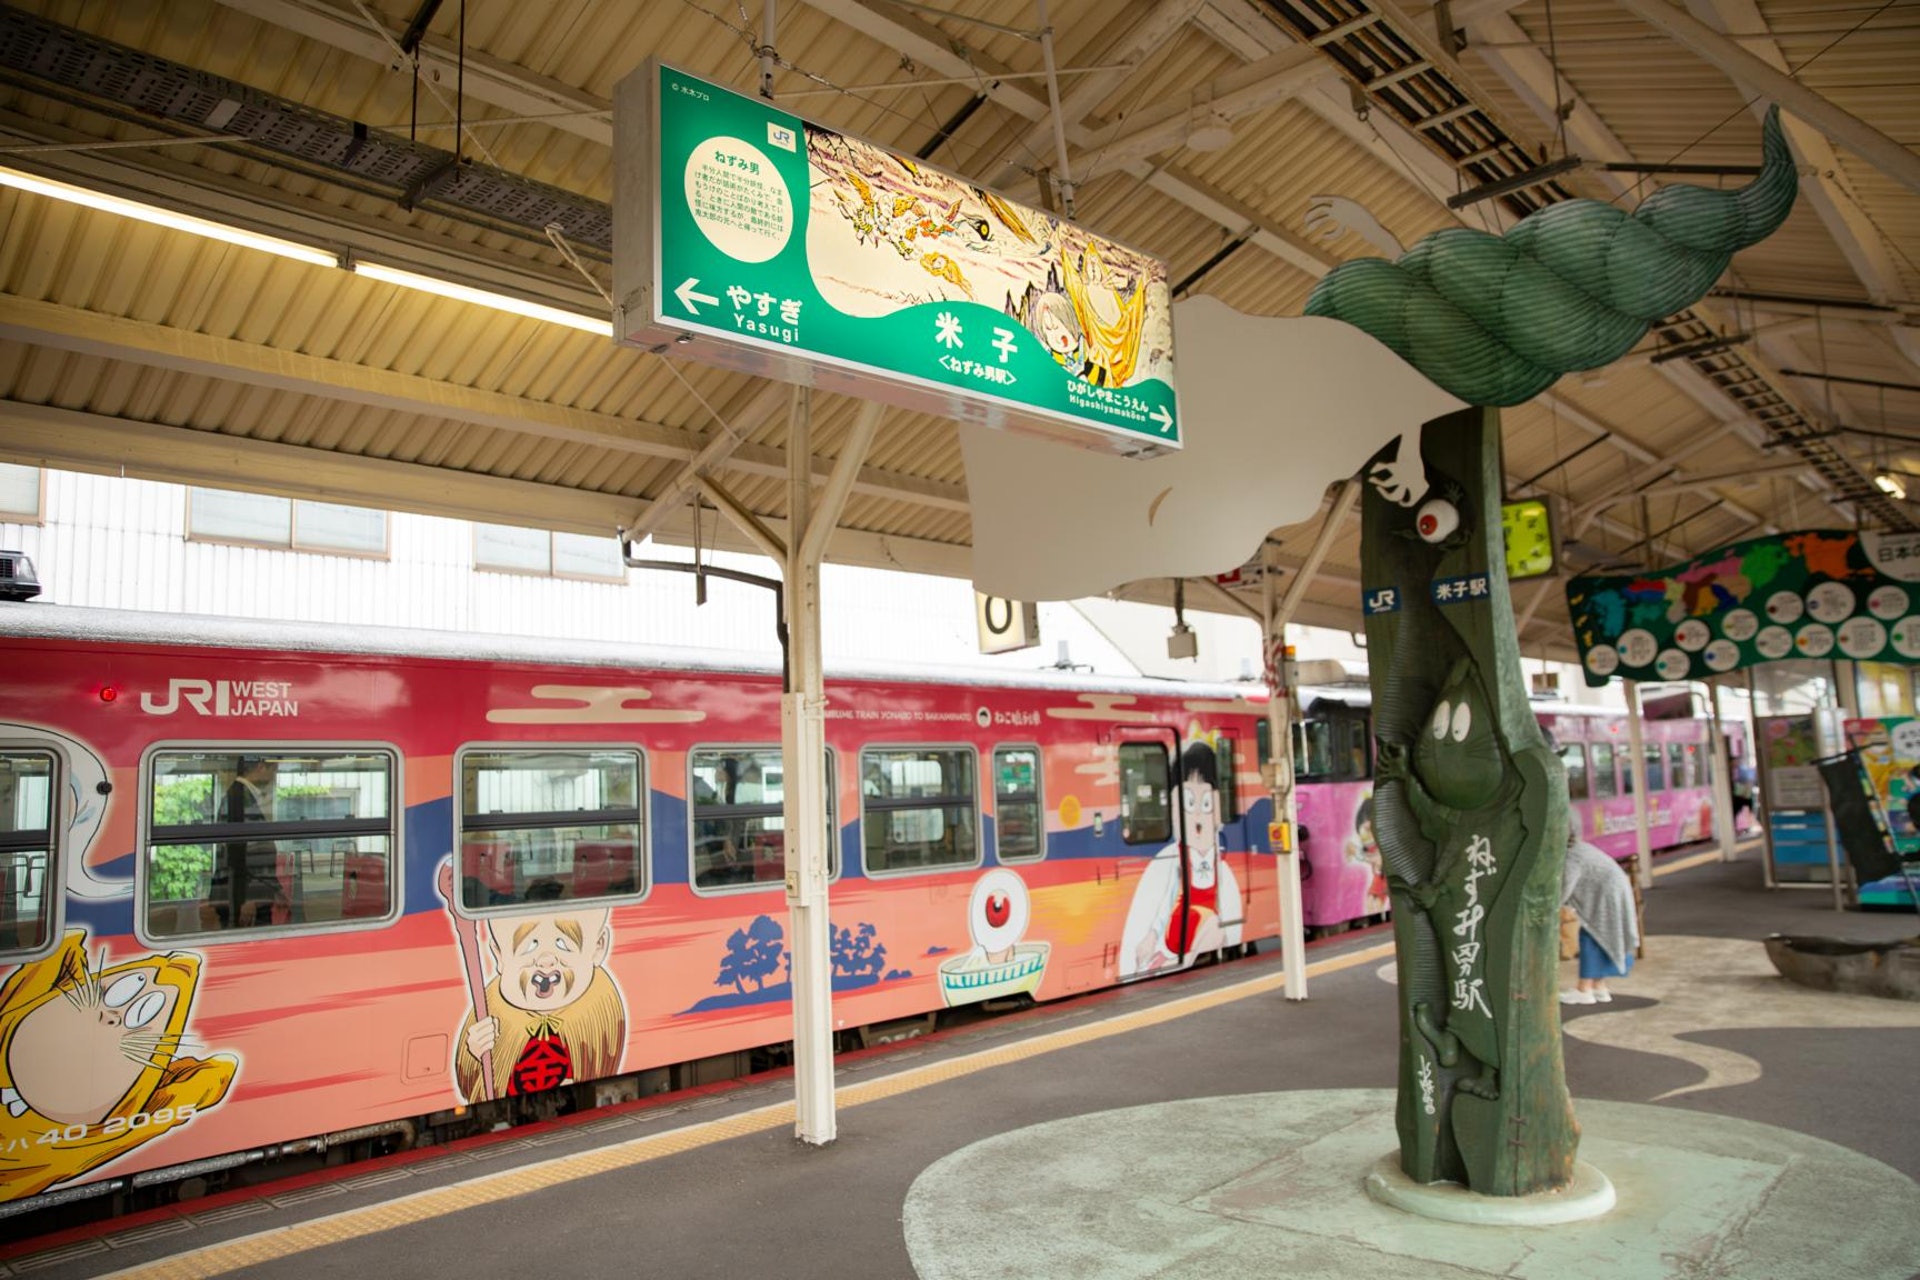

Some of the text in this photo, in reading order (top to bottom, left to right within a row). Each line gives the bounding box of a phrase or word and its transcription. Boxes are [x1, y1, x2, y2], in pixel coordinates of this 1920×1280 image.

[681, 86, 710, 101] 水木プロ
[773, 131, 790, 144] JR
[715, 150, 760, 175] ねずみ男
[726, 285, 803, 325] やすぎ
[733, 313, 799, 342] Yasugi
[1066, 379, 1149, 412] ひがしやまこうえん
[1369, 589, 1395, 608] JR
[1436, 578, 1488, 600] 米子駅
[140, 678, 212, 715] JR
[231, 680, 292, 698] WEST
[230, 700, 298, 717] JAPAN
[36, 1123, 88, 1144] 40
[102, 1103, 197, 1134] 2095
